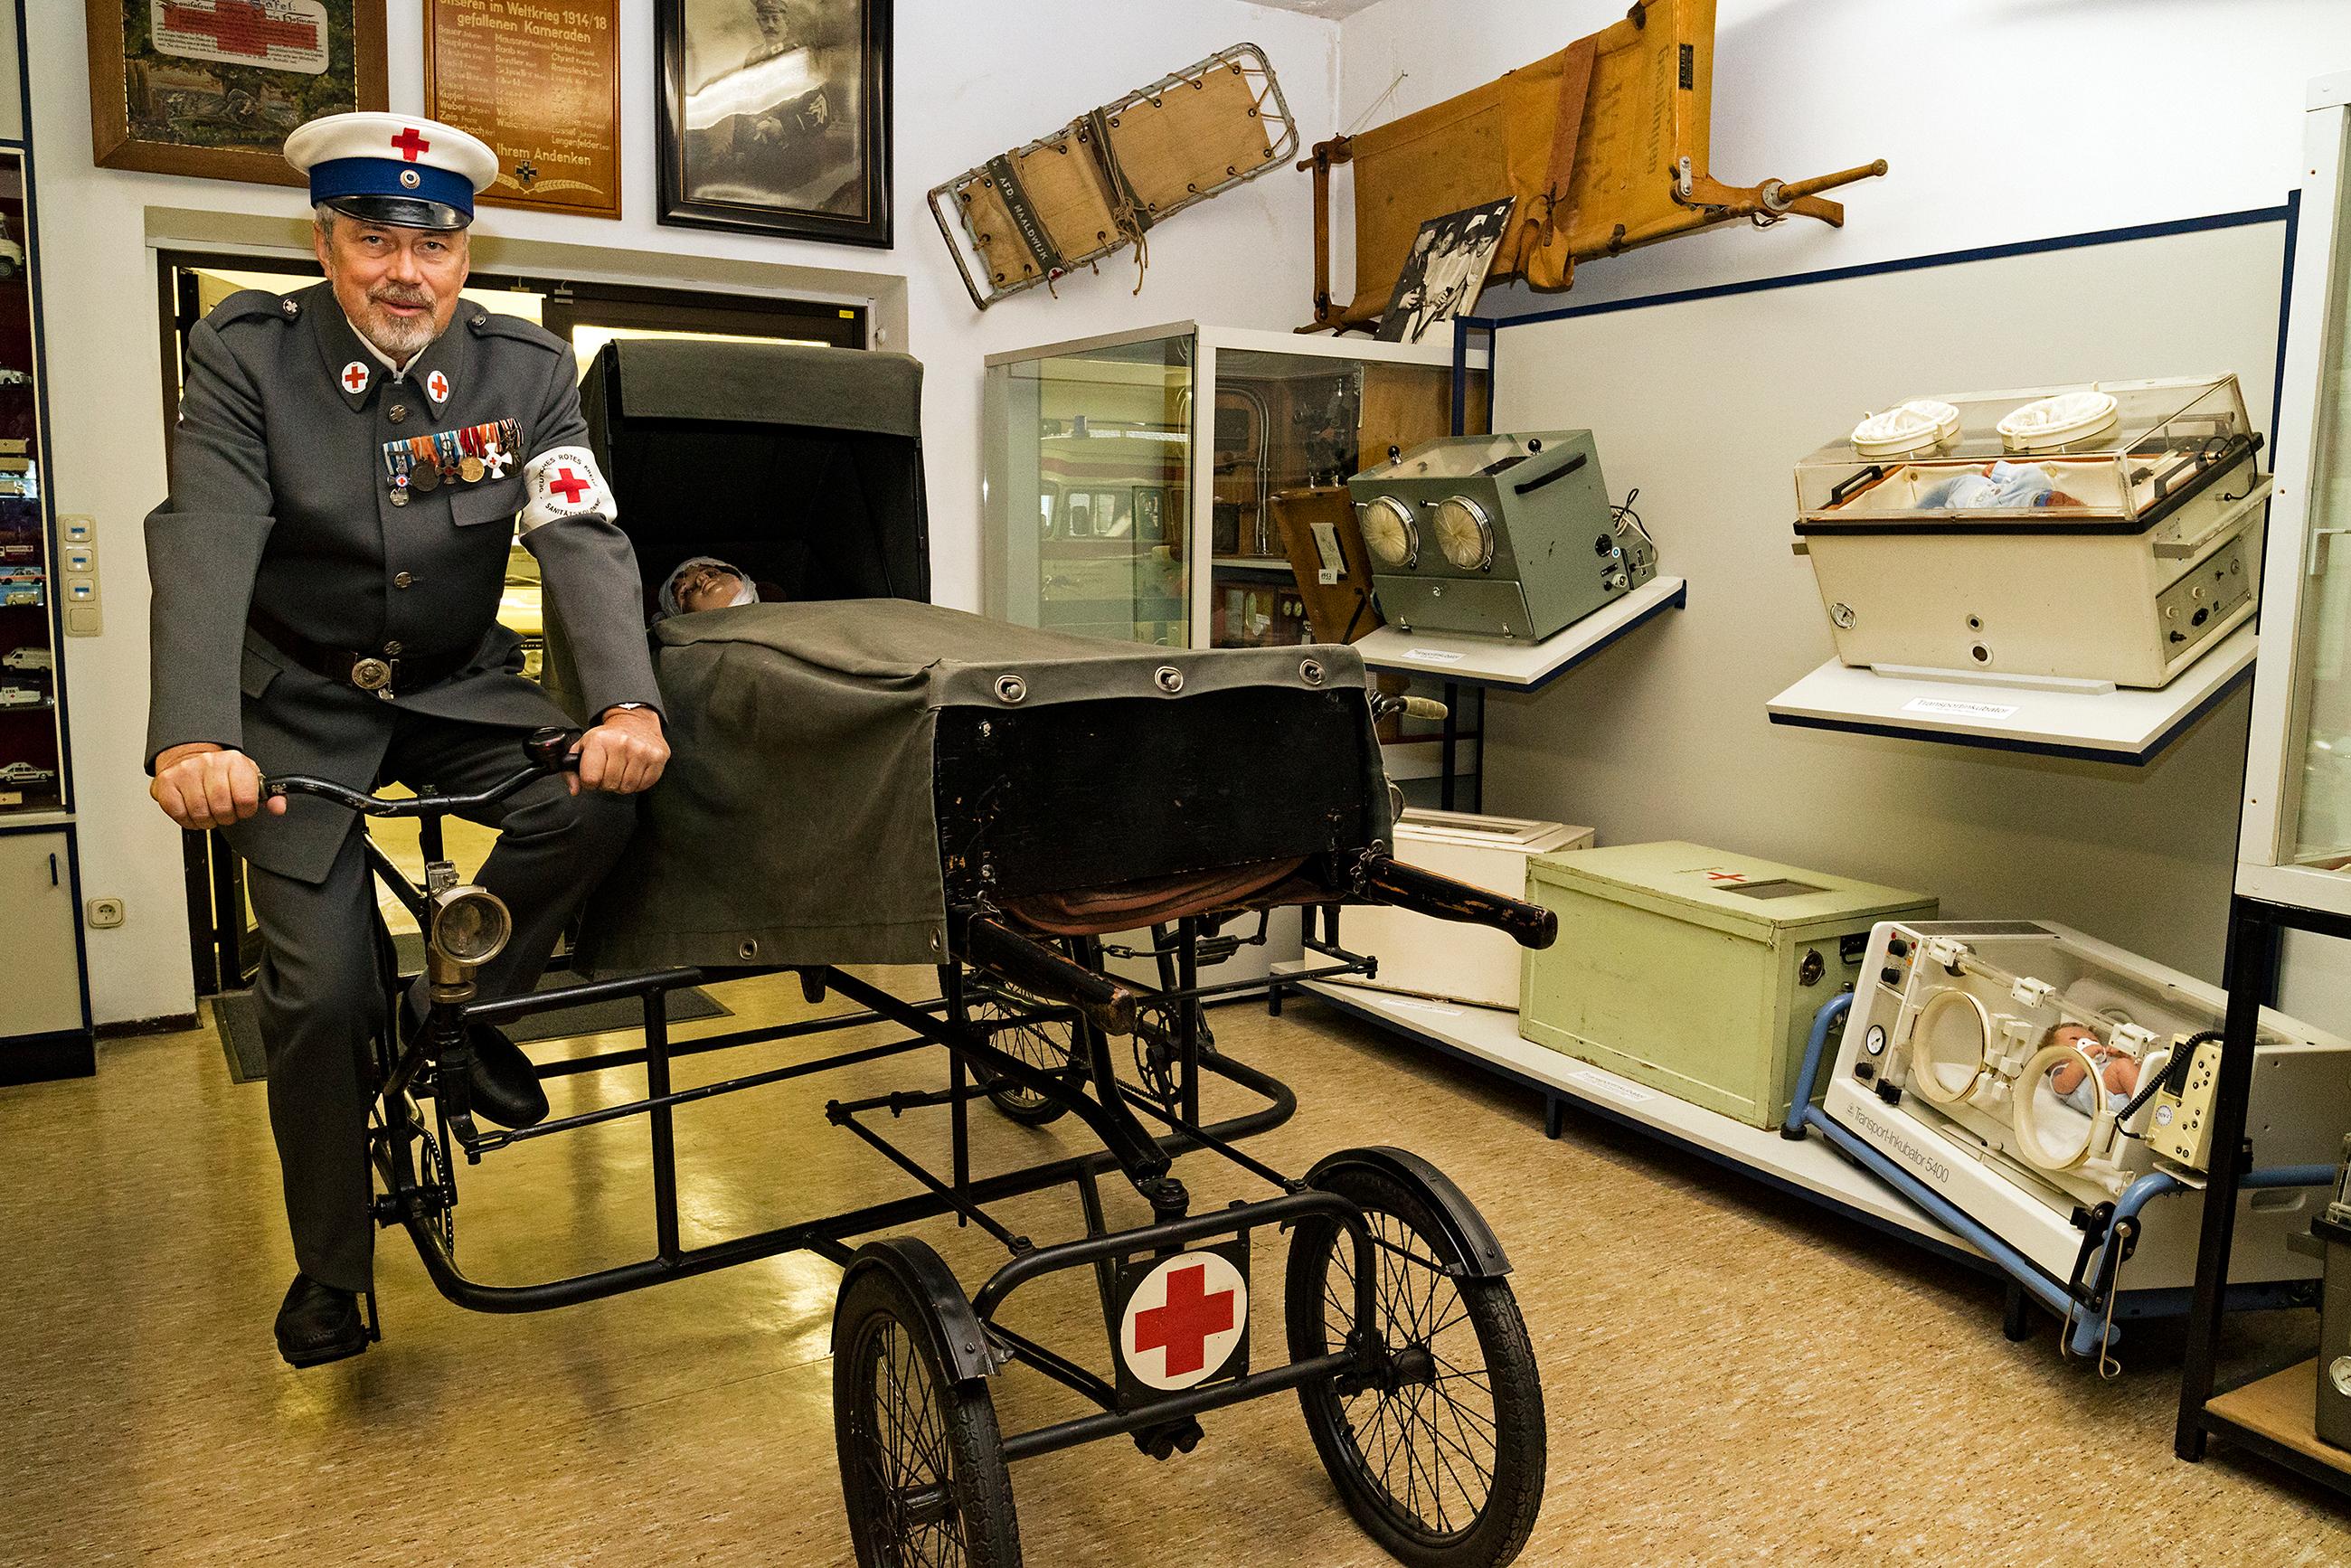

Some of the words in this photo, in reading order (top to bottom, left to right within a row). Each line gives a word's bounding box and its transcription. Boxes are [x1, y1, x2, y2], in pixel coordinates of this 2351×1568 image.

[457, 12, 518, 32] gefallenen
[524, 20, 591, 43] Kameraden
[489, 0, 504, 13] im
[506, 1, 560, 24] Weltkrieg
[562, 10, 608, 30] 1914/18
[439, 100, 467, 112] Weber
[496, 143, 531, 159] Ihrem
[533, 146, 592, 166] Andenken
[1014, 204, 1049, 260] NAALDWIJK
[558, 453, 581, 465] ROTES
[1855, 1105, 1926, 1167] Transport-Inkubator
[1925, 1157, 1950, 1184] 5400
